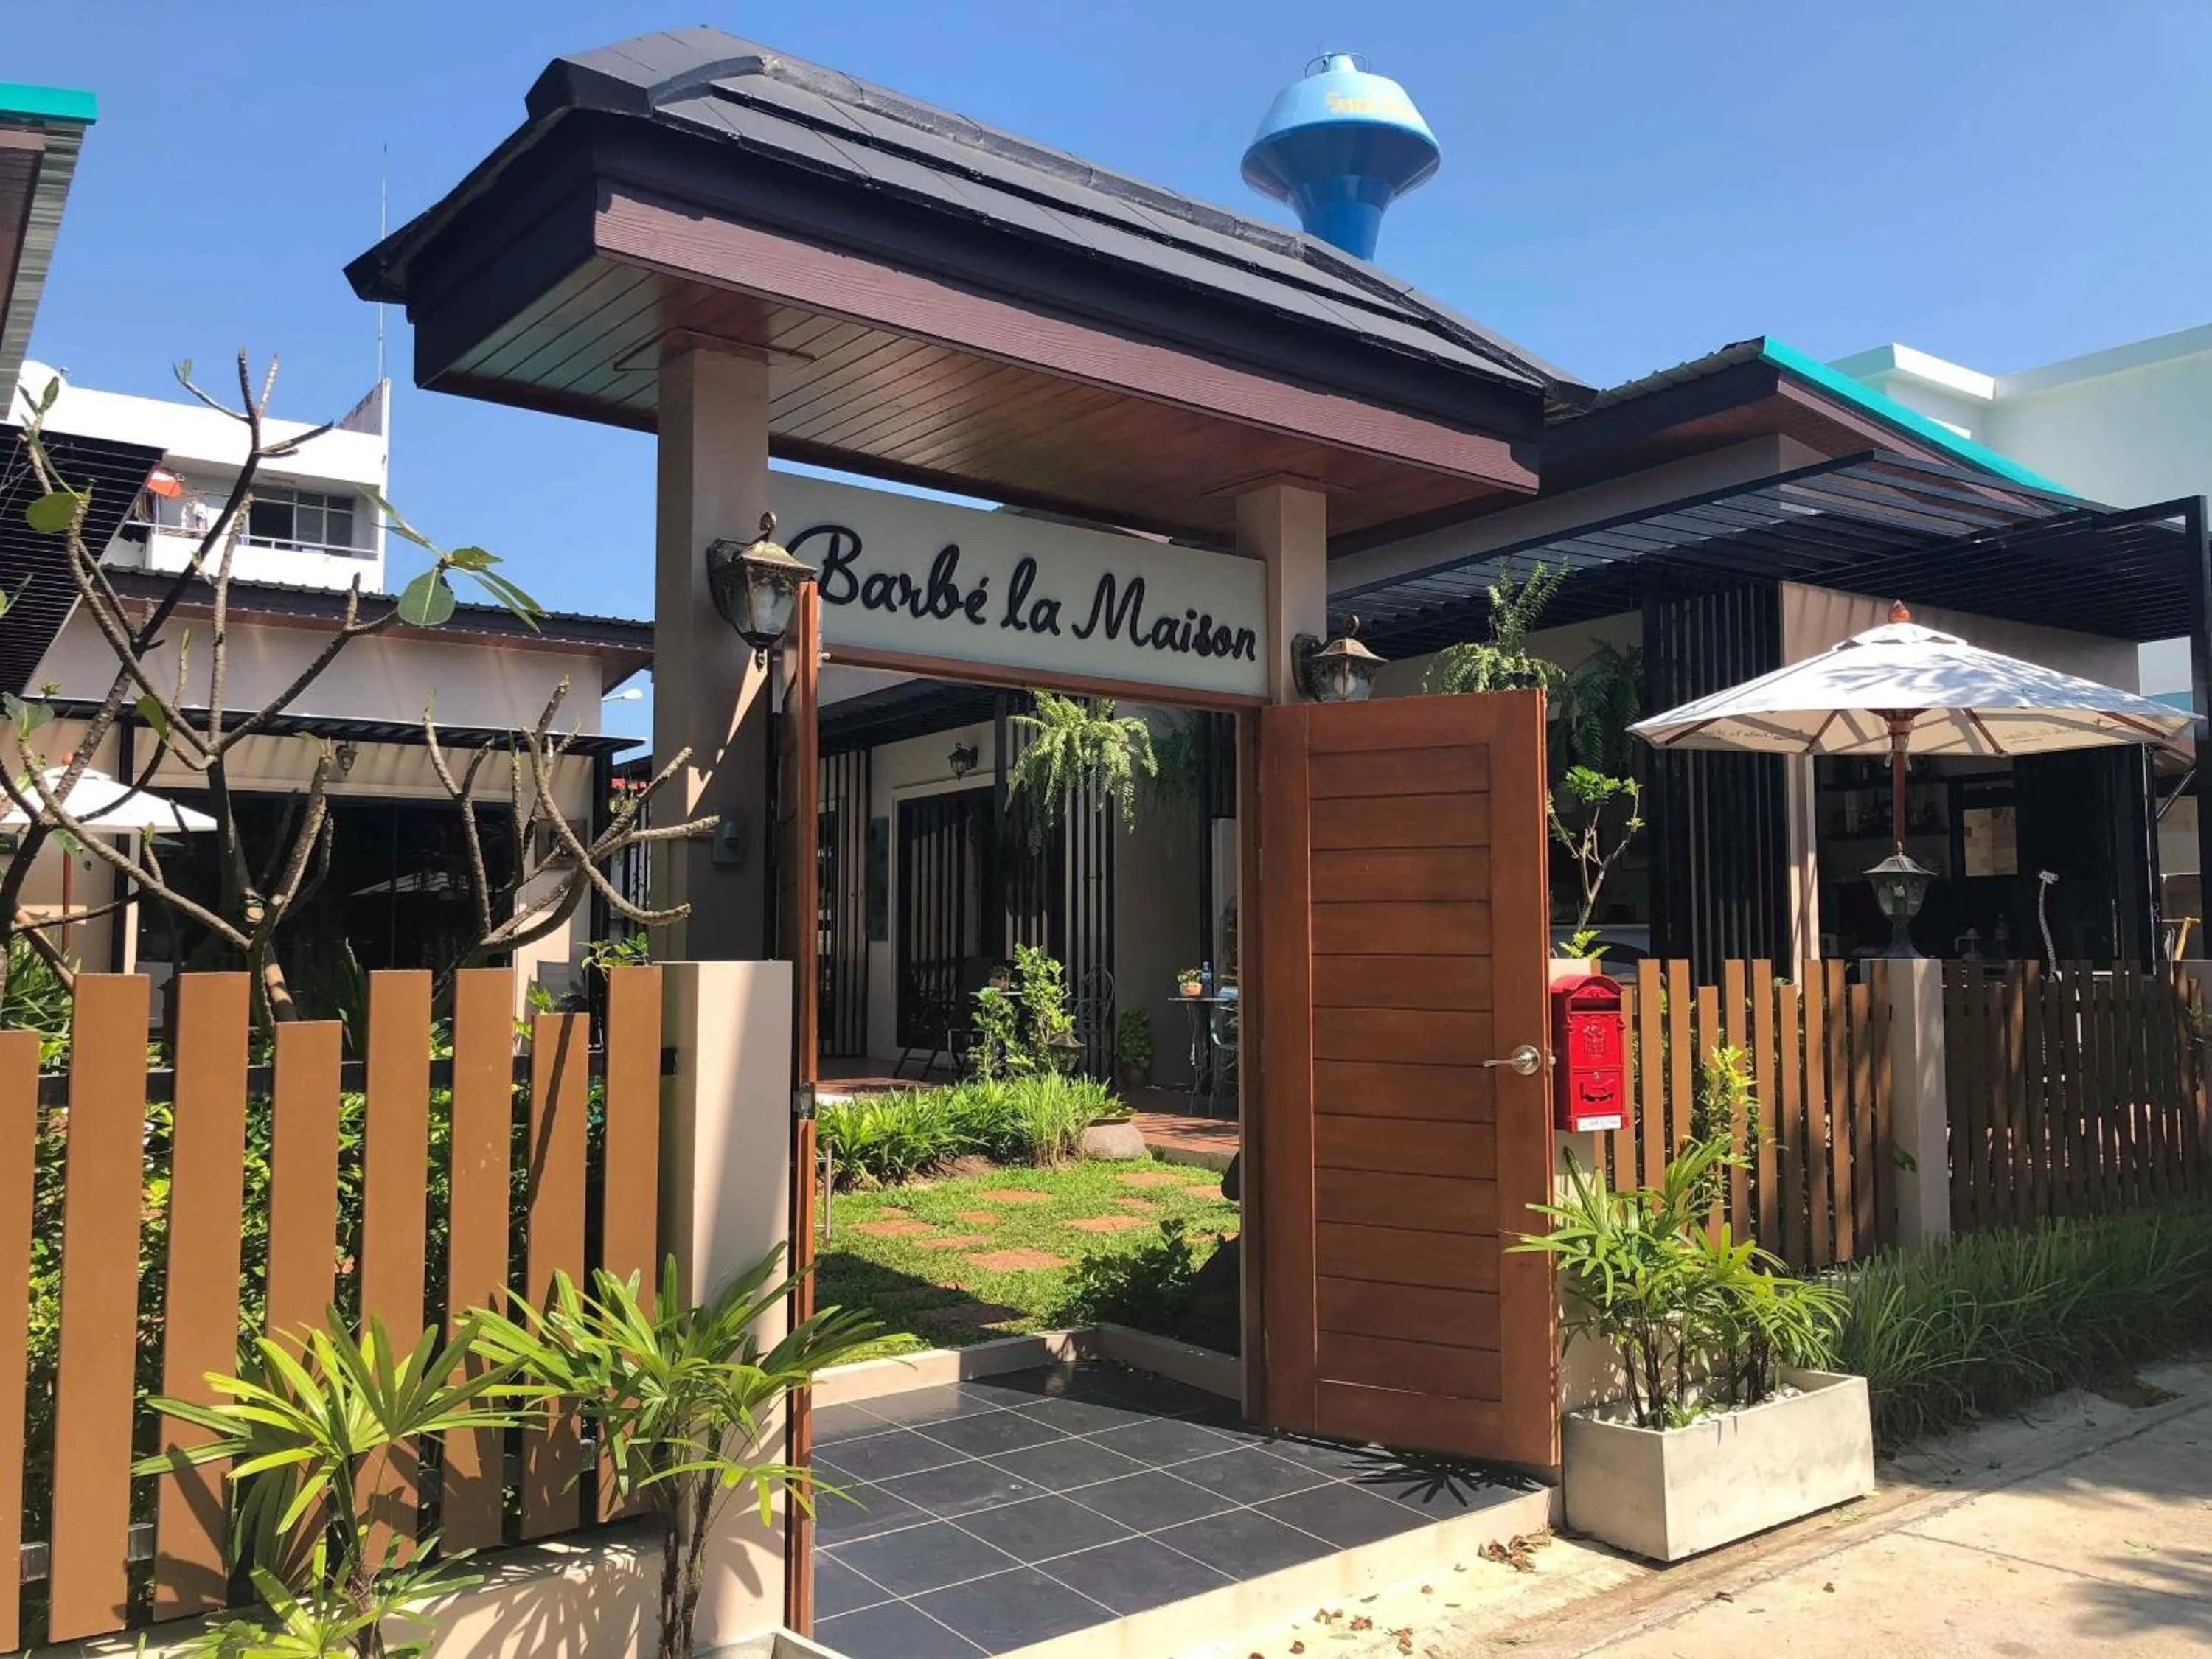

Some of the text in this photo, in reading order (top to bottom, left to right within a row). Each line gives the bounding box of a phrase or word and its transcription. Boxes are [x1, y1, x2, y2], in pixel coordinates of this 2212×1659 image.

[785, 524, 1256, 661] Barbé la Maison
